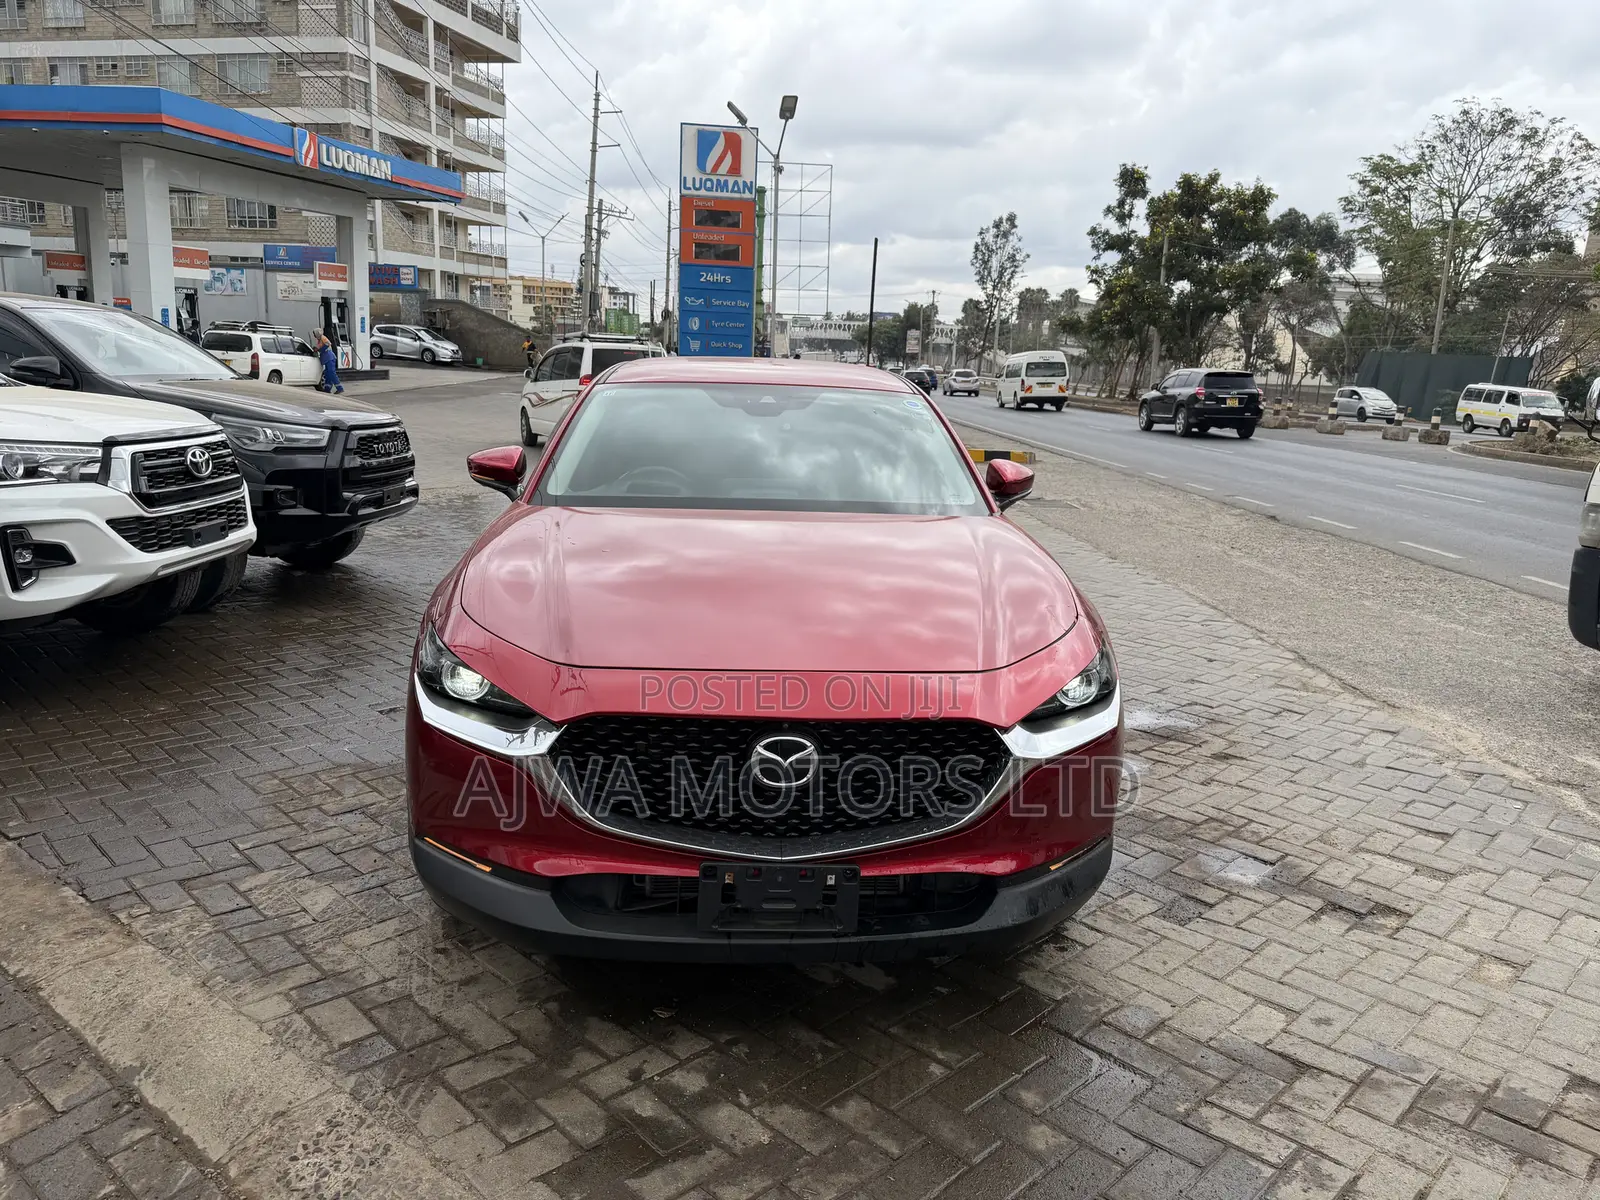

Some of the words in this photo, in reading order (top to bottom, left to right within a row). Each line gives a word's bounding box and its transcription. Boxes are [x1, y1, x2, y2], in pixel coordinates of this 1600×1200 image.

[320, 143, 391, 181] LUQMAN
[683, 176, 753, 194] LUQMAN
[693, 199, 714, 207] Diesel
[692, 232, 725, 241] Unleaded
[700, 272, 731, 283] 24Hrs
[711, 298, 736, 306] Service
[737, 300, 750, 308] Bay
[712, 320, 725, 328] Tyre
[373, 440, 402, 454] TOYOTA
